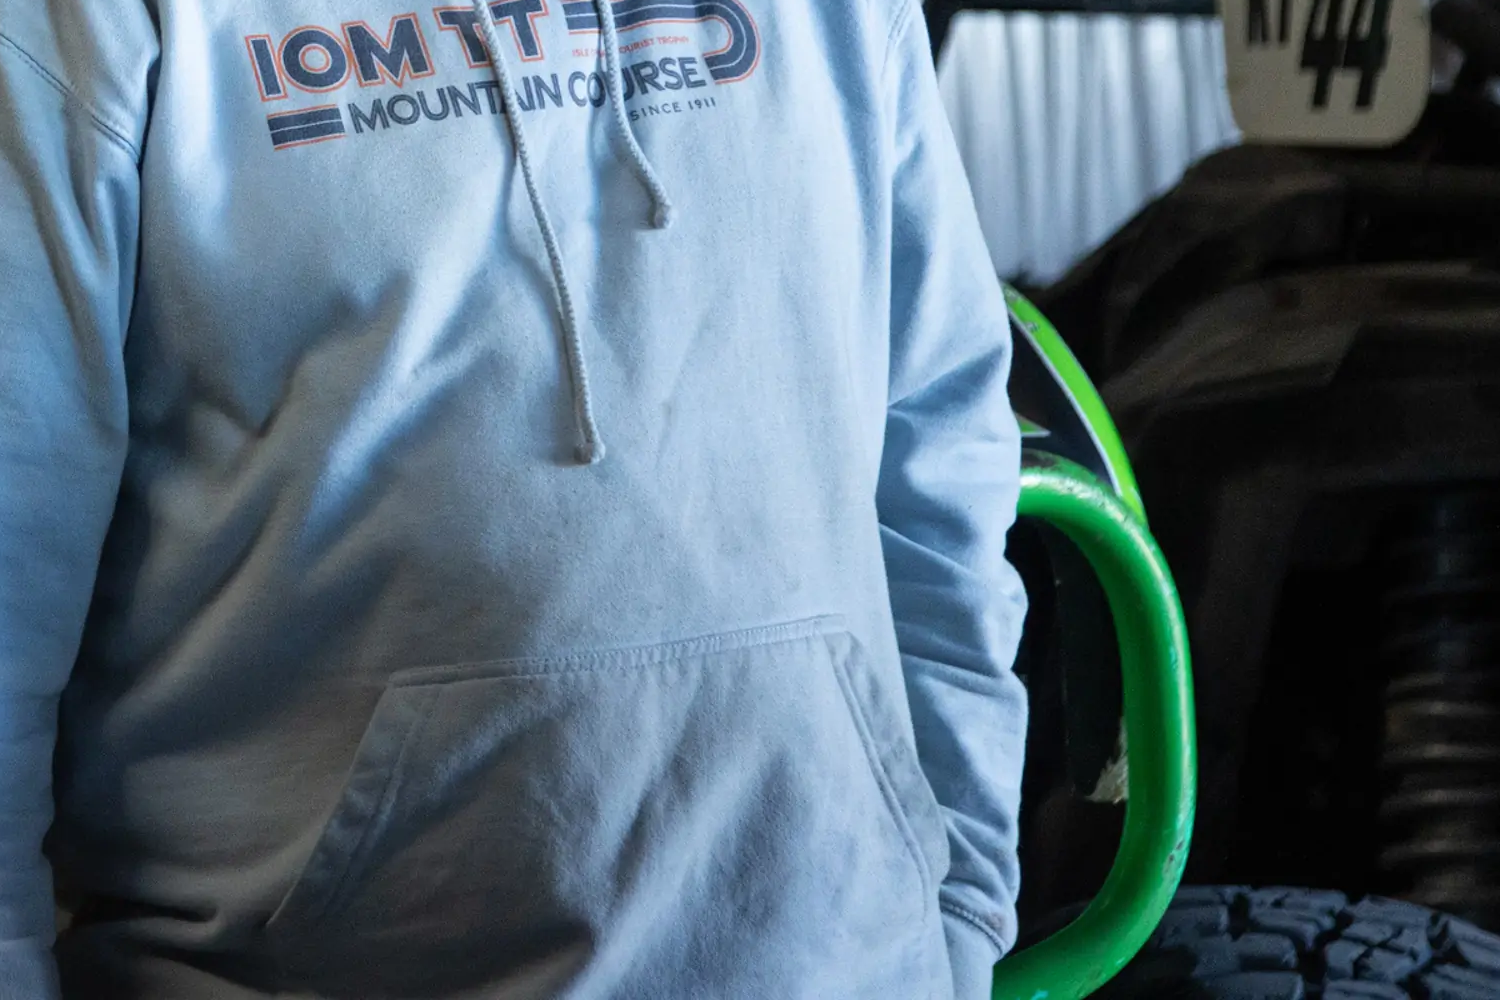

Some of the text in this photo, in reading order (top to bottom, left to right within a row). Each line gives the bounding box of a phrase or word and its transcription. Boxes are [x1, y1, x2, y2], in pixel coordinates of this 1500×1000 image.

[244, 12, 436, 102] IOM
[618, 37, 654, 54] OURIST
[629, 96, 716, 122] SINCE 1911
